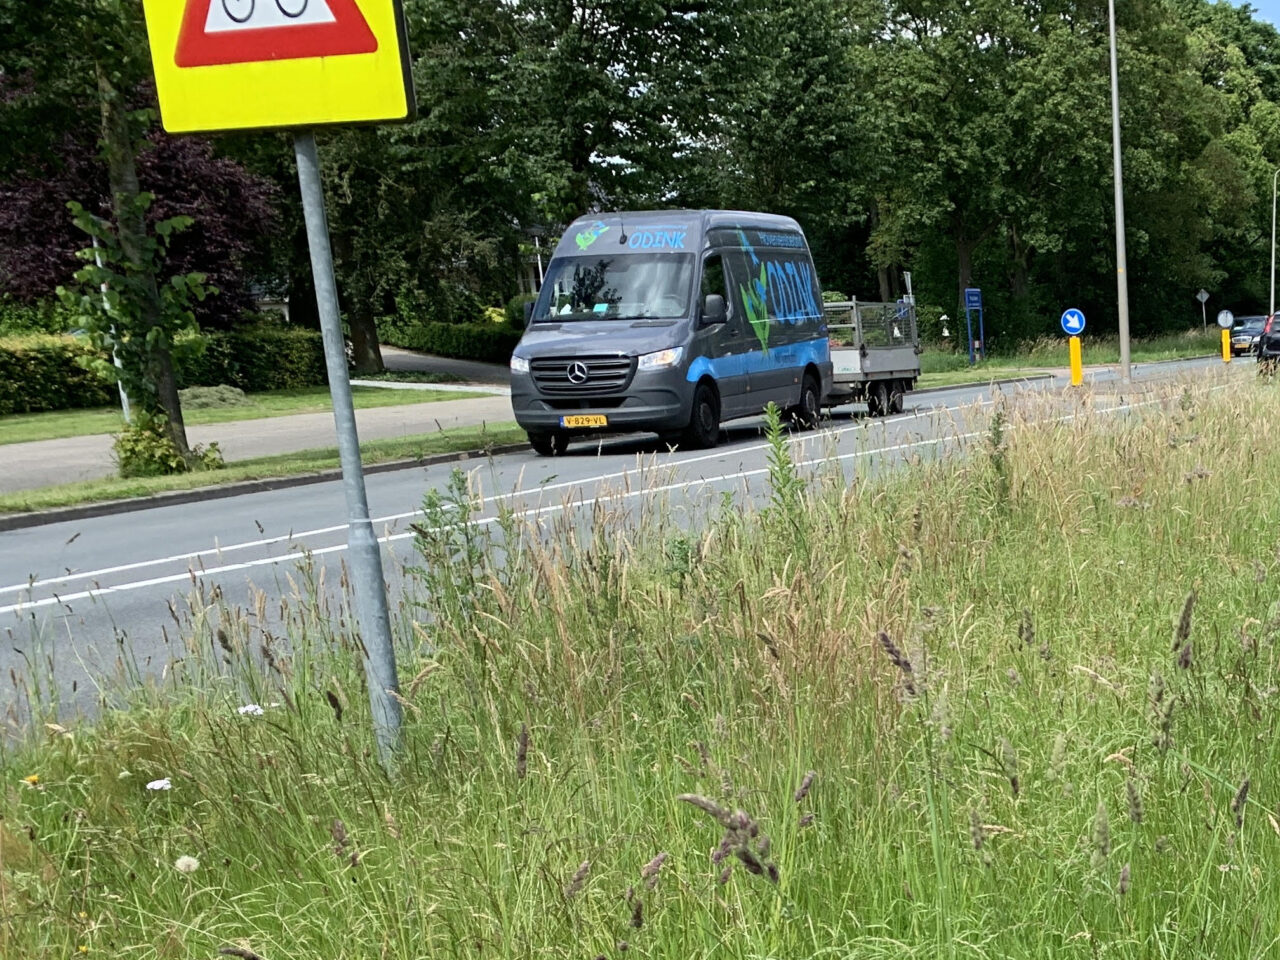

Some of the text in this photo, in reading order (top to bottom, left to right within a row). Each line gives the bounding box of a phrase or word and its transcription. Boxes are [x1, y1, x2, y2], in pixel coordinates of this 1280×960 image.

[629, 231, 687, 249] ODINK
[767, 260, 820, 324] ODINK
[566, 416, 605, 425] V-829-VL
